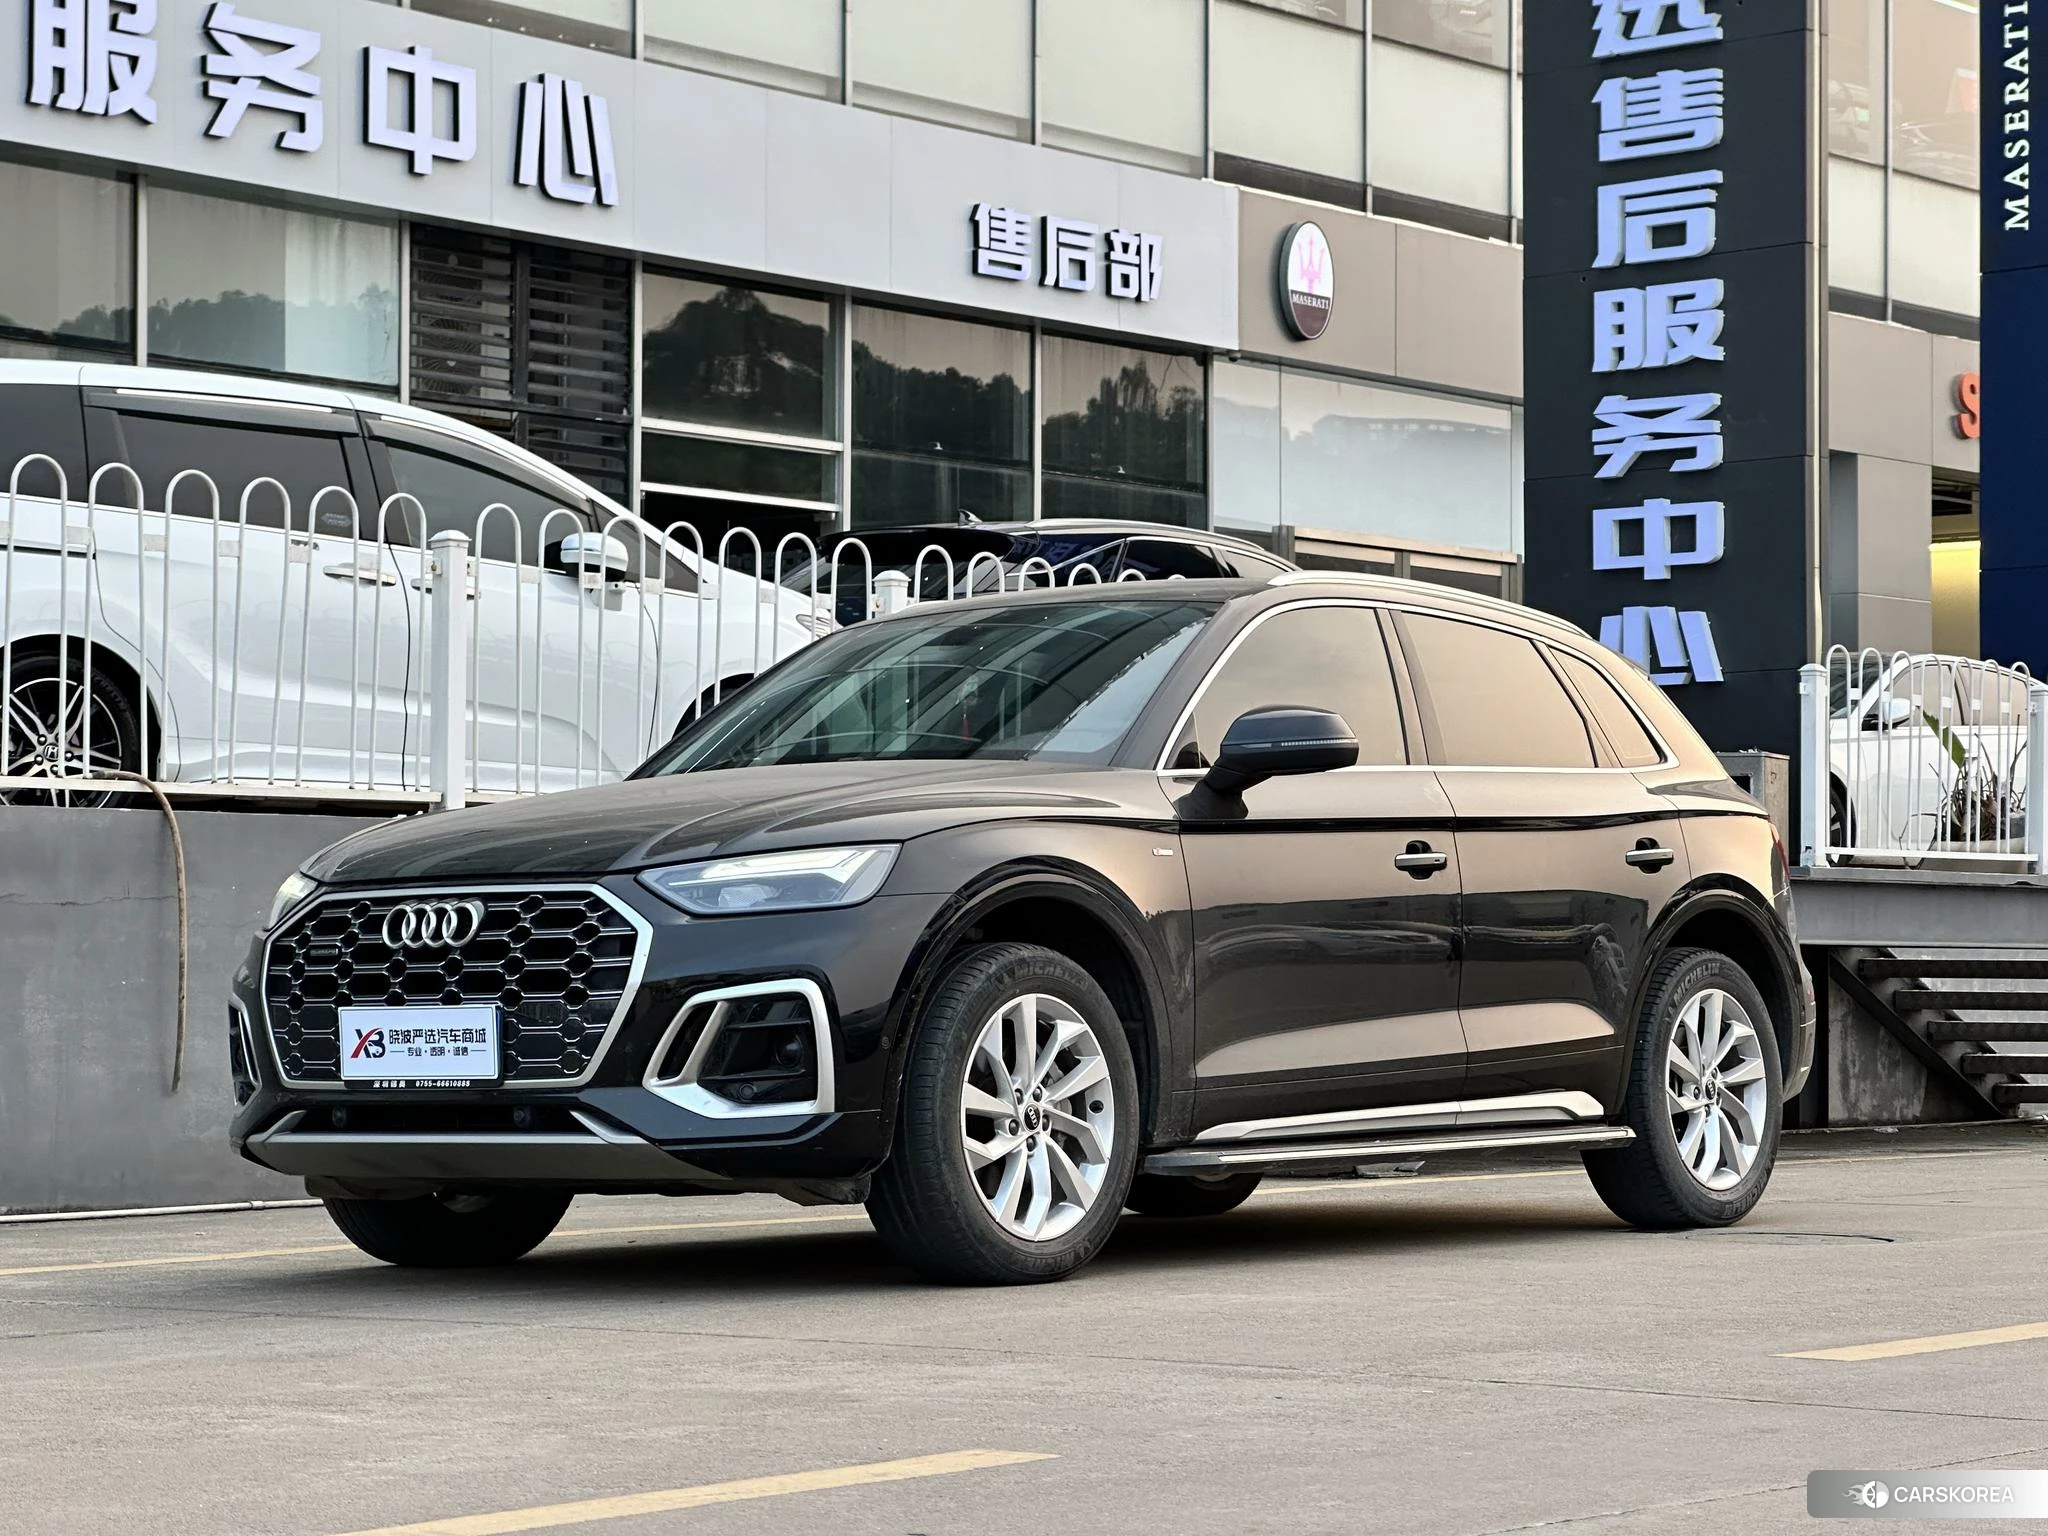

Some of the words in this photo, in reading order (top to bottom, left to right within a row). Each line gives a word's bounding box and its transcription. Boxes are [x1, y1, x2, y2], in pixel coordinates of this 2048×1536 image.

[26, 0, 619, 206] 服务中心
[2003, 0, 2029, 231] MASERATI
[970, 202, 1164, 302] 售后部
[1292, 293, 1329, 310] MASERATI
[388, 1028, 487, 1045] 晓波严选汽车商城
